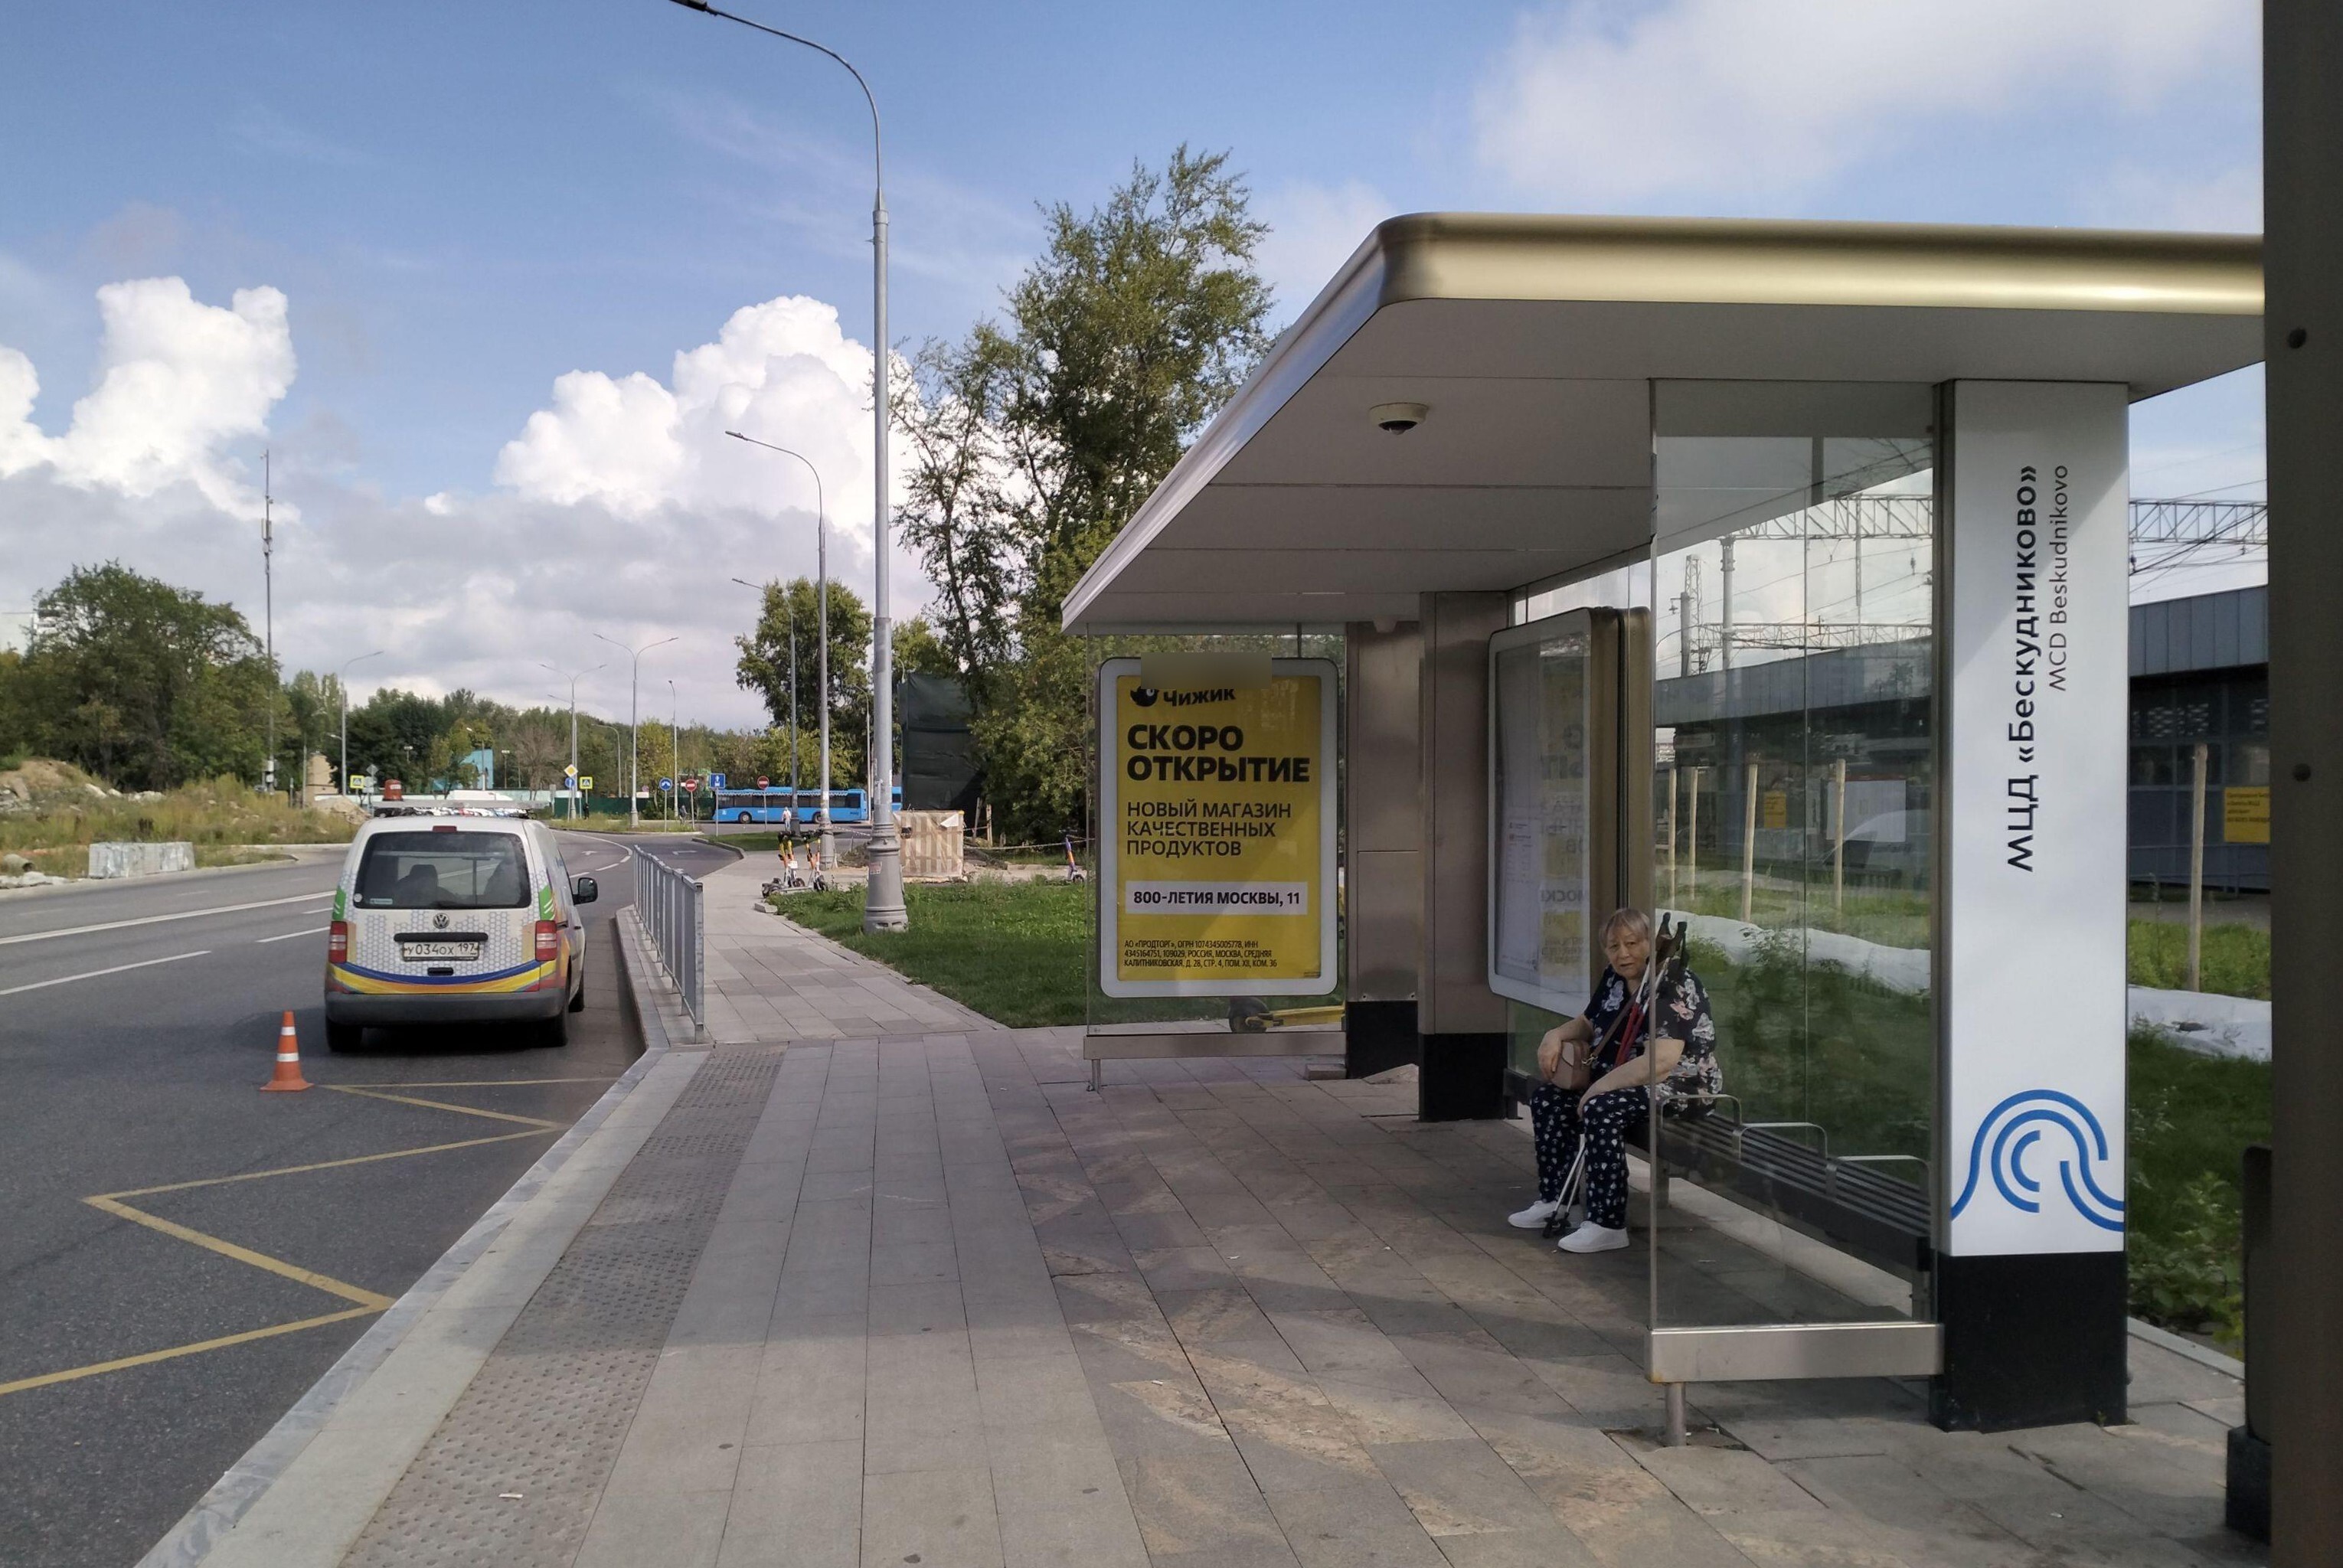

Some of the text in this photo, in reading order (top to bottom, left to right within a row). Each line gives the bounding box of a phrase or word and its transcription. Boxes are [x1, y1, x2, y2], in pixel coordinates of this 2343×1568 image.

[2048, 465, 2068, 692] MCD Beskudnikovo
[2007, 466, 2042, 873] МЦД «Бескудниково»
[1163, 688, 1237, 707] Чижик
[1127, 724, 1243, 751] СКОРО
[1126, 755, 1310, 782] ОТКРЫТИЕ
[1127, 799, 1292, 818] НОВЫЙ МАГАЗИН
[1126, 821, 1276, 837] КАЧЕСТВЕННЫХ
[1126, 840, 1242, 858] ПРОДУКТОВ
[1133, 891, 1300, 906] 800-ЛЕТИЯ МОСКВЫ, 11
